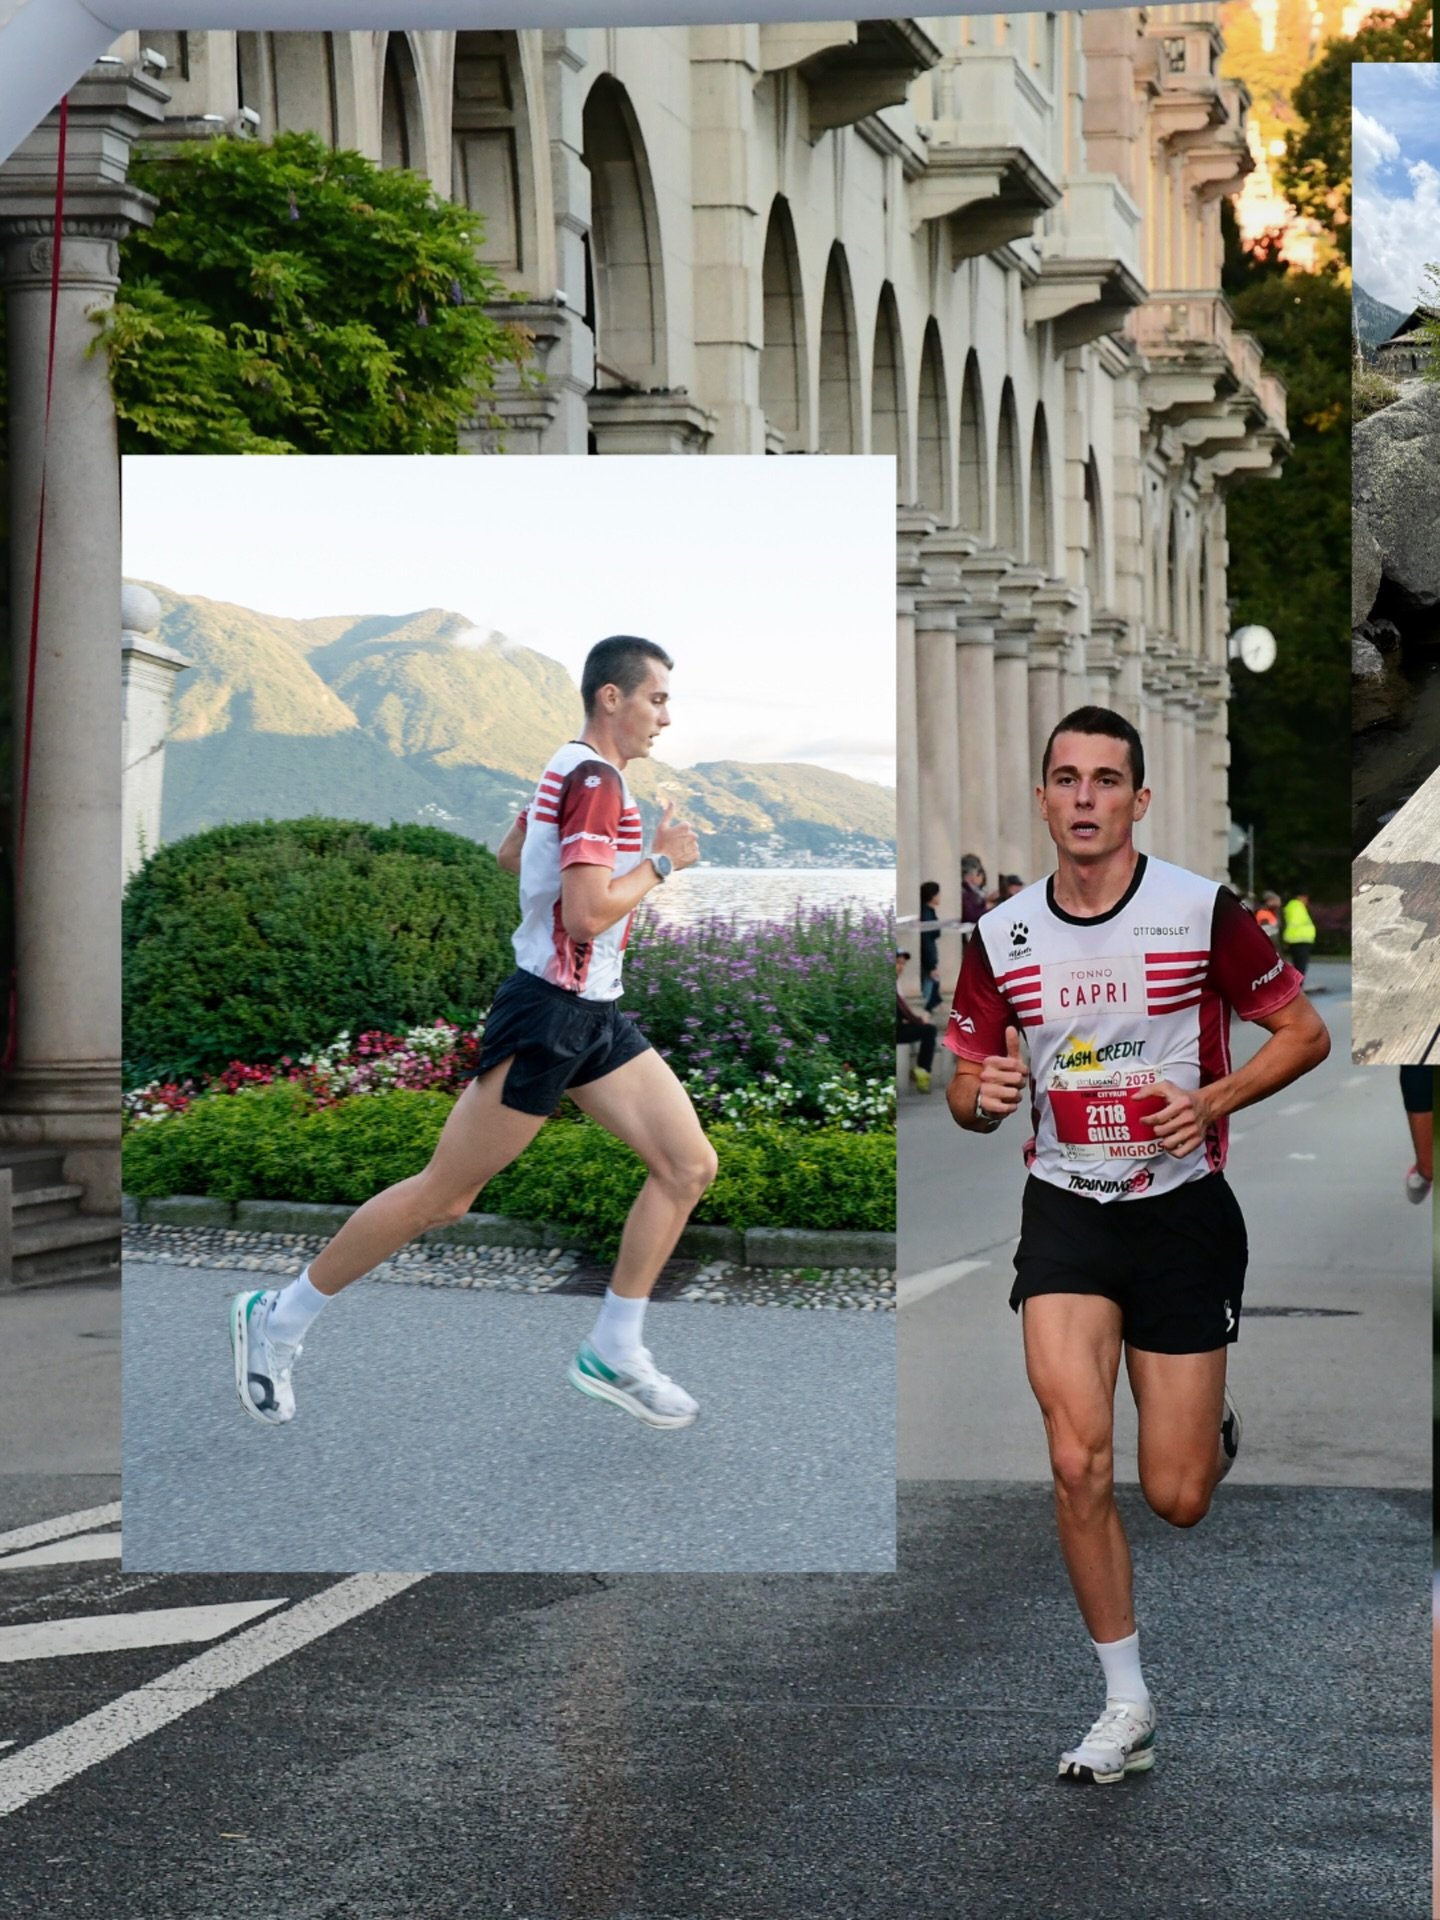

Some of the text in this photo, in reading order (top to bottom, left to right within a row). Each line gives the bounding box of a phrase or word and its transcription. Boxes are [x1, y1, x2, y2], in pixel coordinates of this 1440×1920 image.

[1133, 926, 1190, 936] OTTOBOSLEY
[1070, 968, 1113, 980] TONNO
[1060, 982, 1127, 1008] CAPRI
[1053, 1040, 1146, 1071] FLASH CREDIT
[1125, 1072, 1156, 1087] 2025
[1086, 1104, 1127, 1125] 2118
[1087, 1126, 1131, 1142] GILLES
[1108, 1141, 1164, 1158] MIGROS
